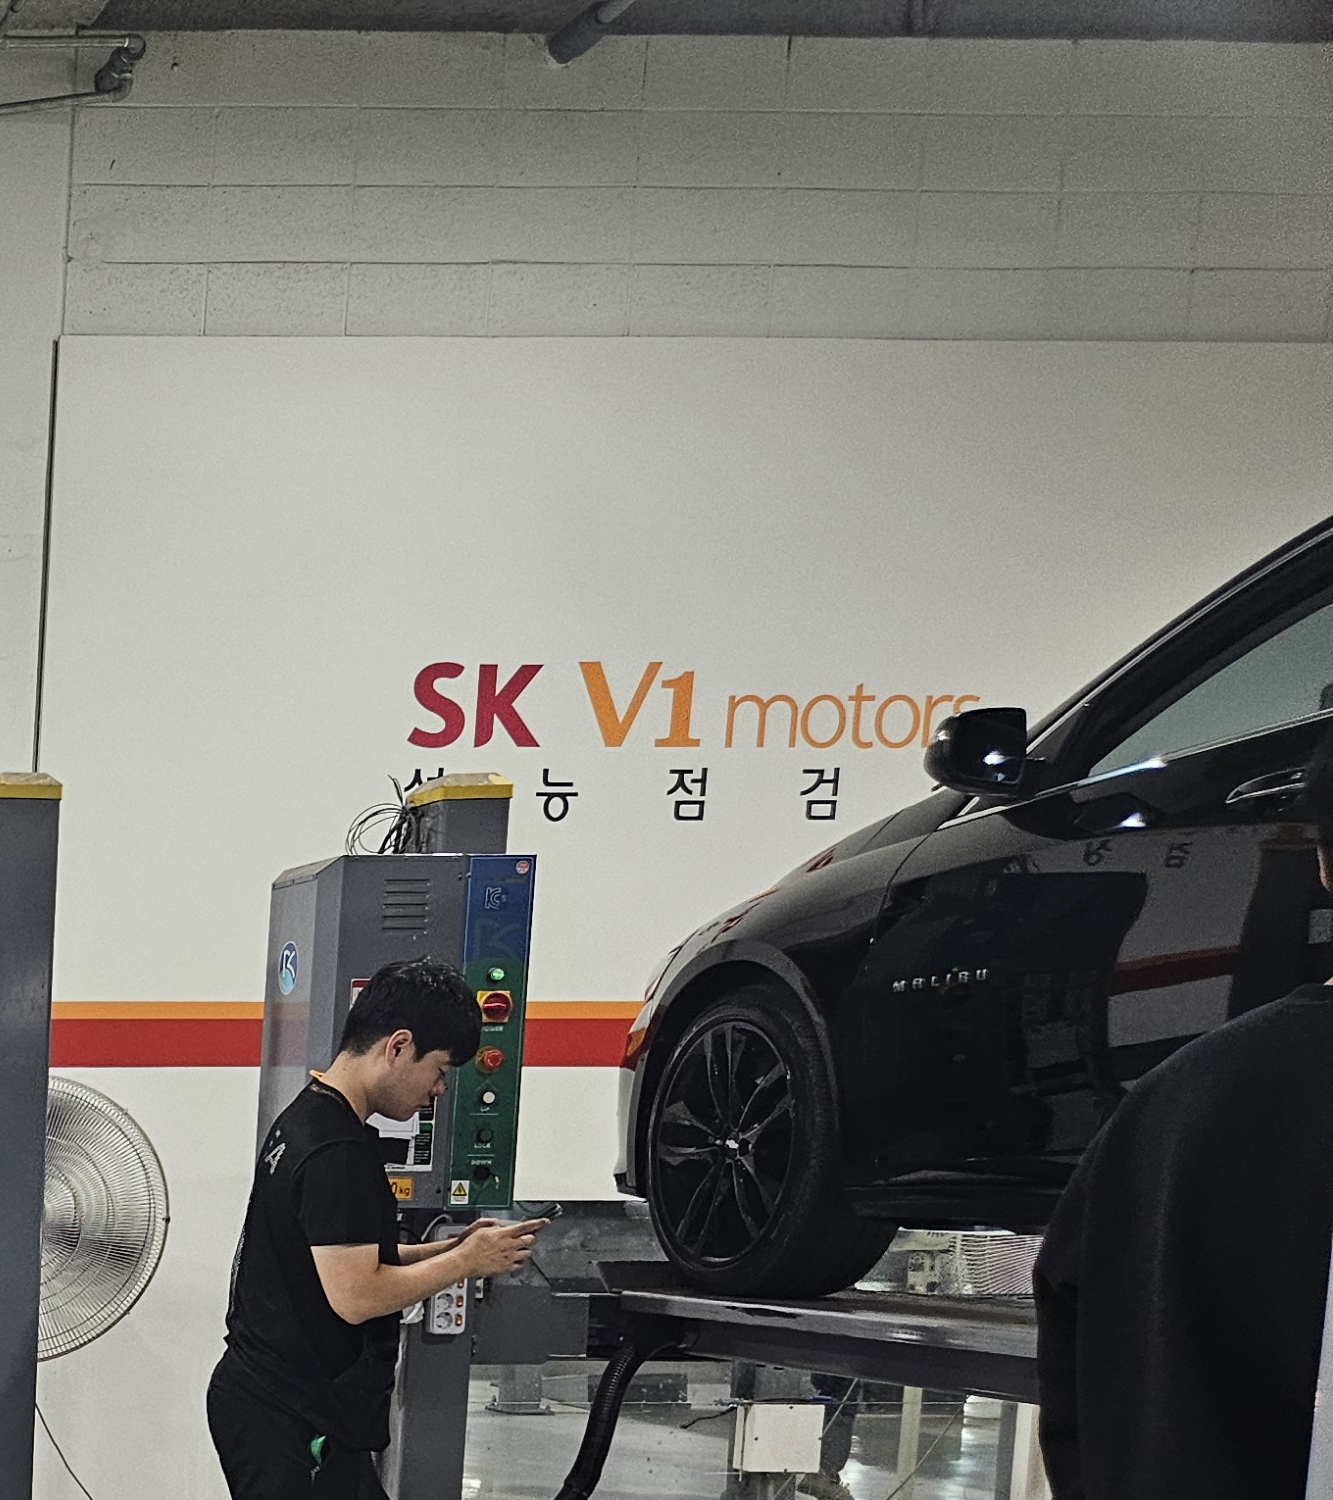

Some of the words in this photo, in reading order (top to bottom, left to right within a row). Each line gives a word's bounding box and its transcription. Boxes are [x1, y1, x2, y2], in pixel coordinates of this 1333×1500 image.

[407, 661, 545, 749] SK
[578, 660, 701, 748] V1
[892, 968, 989, 993] MALIBU
